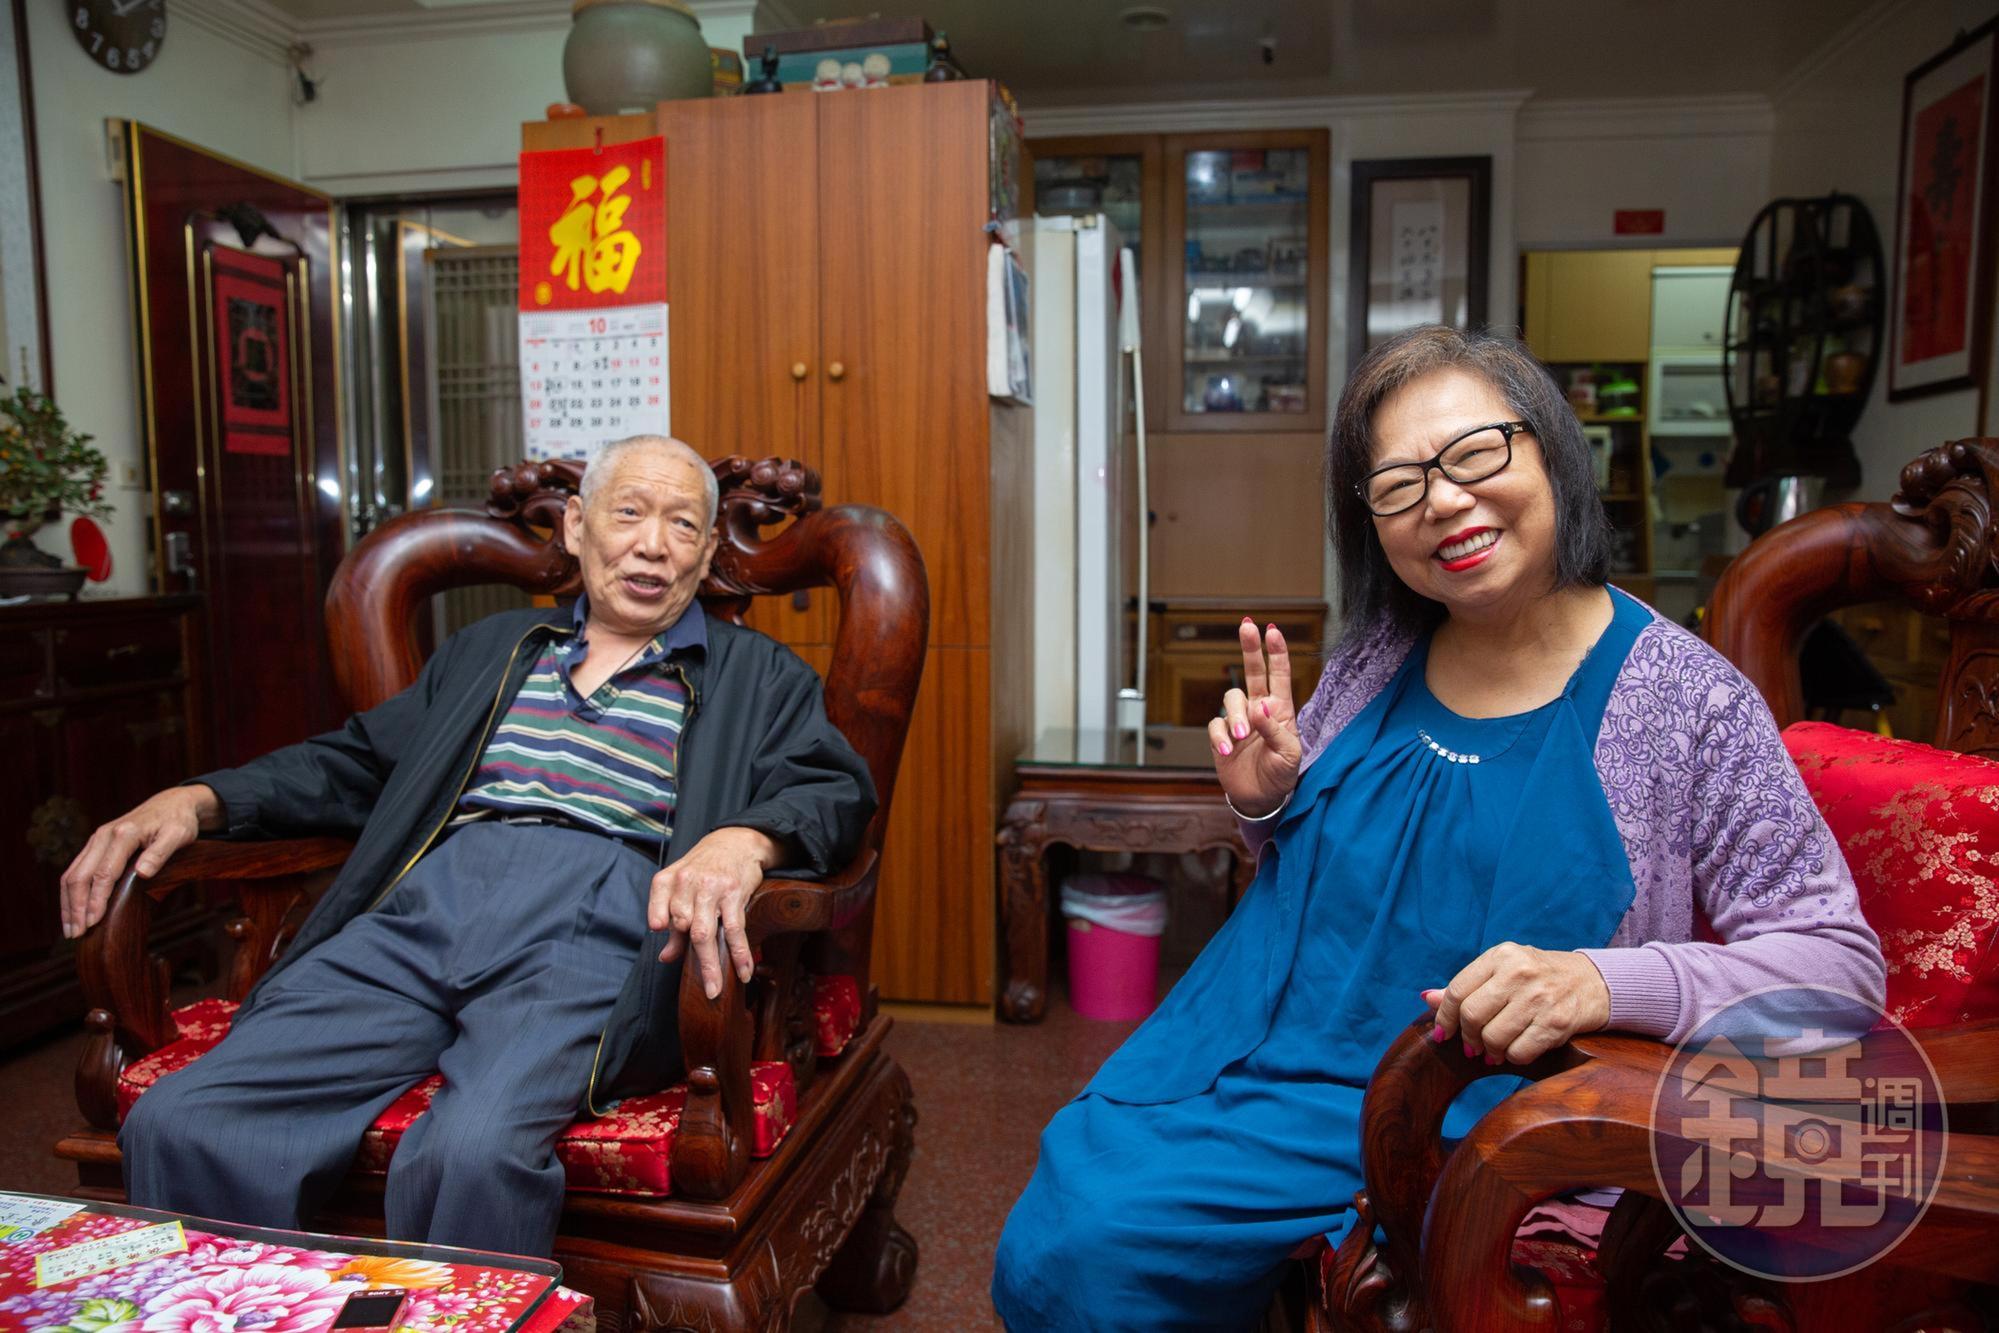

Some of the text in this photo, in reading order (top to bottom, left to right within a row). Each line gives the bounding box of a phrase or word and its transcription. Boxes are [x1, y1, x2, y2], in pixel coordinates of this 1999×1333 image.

[75, 7, 89, 29] 8
[90, 31, 104, 53] 7
[106, 47, 120, 68] 6
[550, 165, 642, 294] 福
[588, 317, 607, 335] 10
